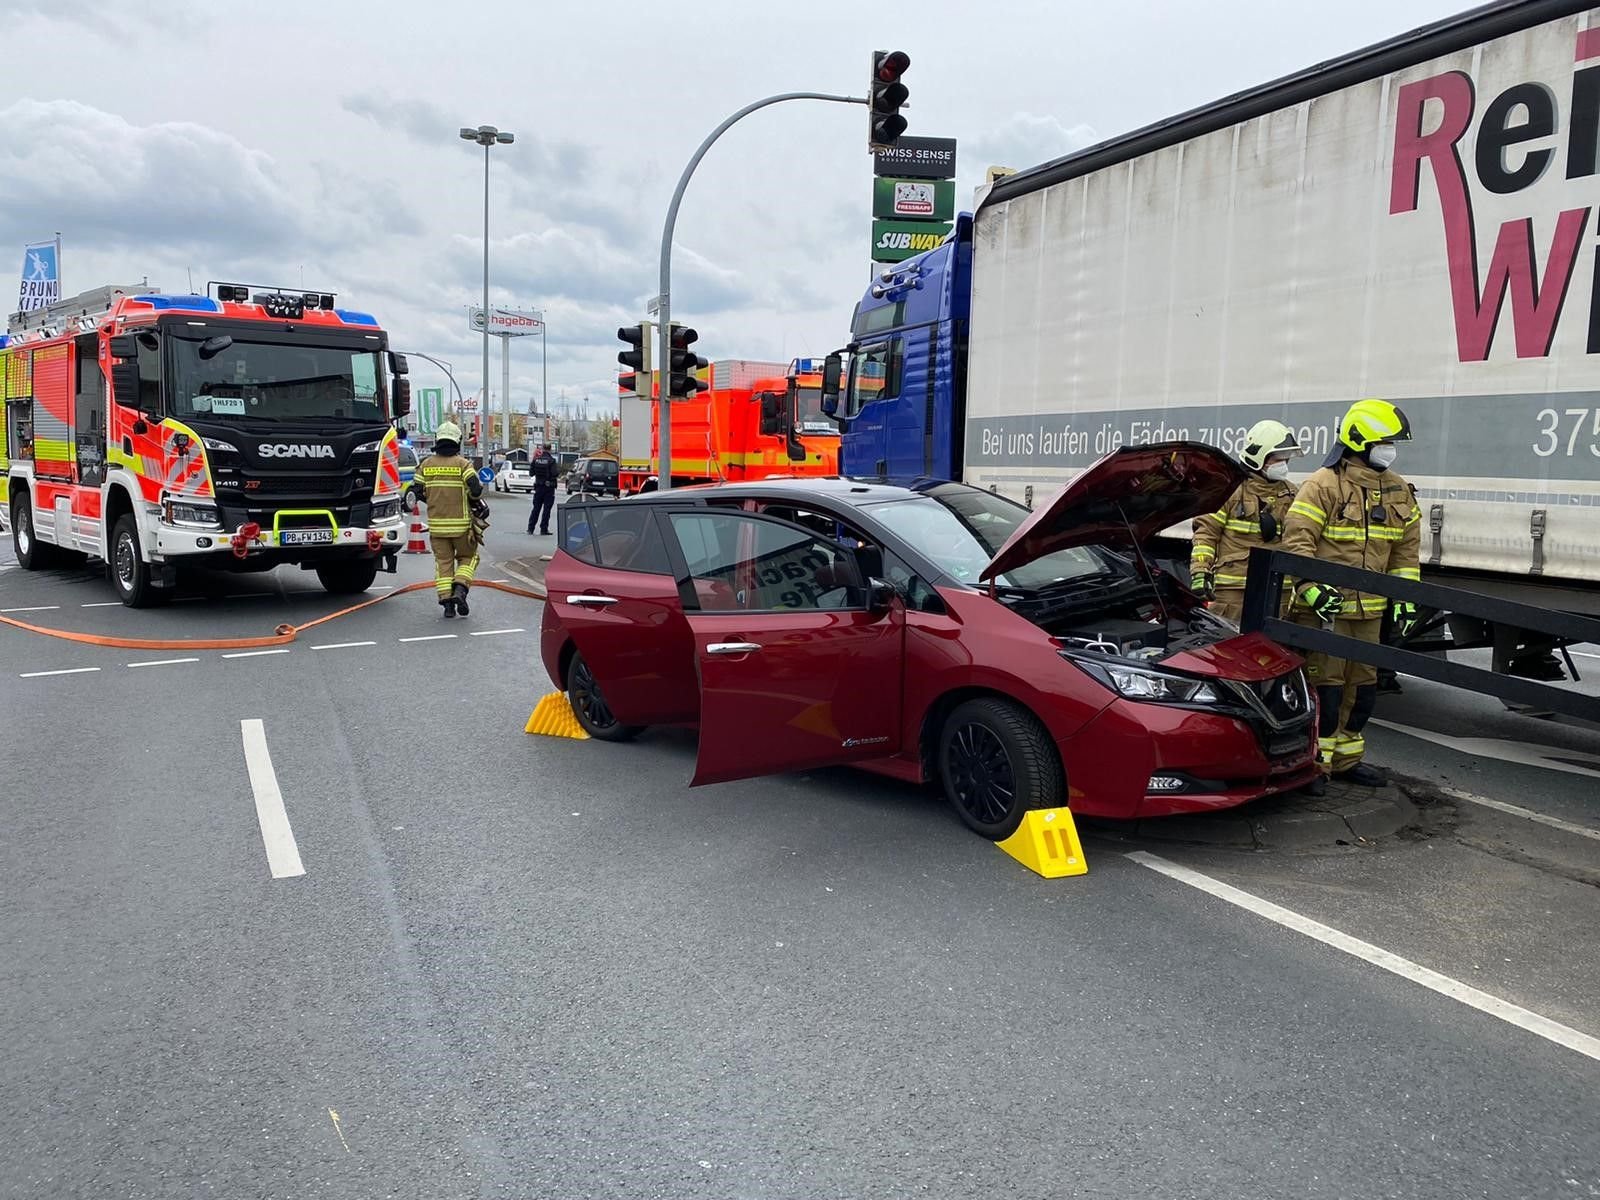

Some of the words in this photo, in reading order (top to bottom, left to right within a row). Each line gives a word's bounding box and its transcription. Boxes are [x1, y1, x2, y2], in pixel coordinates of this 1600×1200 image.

[879, 148, 912, 157] SWISS
[916, 149, 951, 160] SENSE
[876, 232, 945, 249] SUBWAY
[20, 281, 58, 297] BRUNO
[982, 427, 1004, 456] Bei
[1008, 432, 1035, 456] uns
[1039, 424, 1089, 456] laufen
[1095, 422, 1124, 455] die
[258, 444, 336, 458] SCANIA
[286, 533, 297, 542] PB
